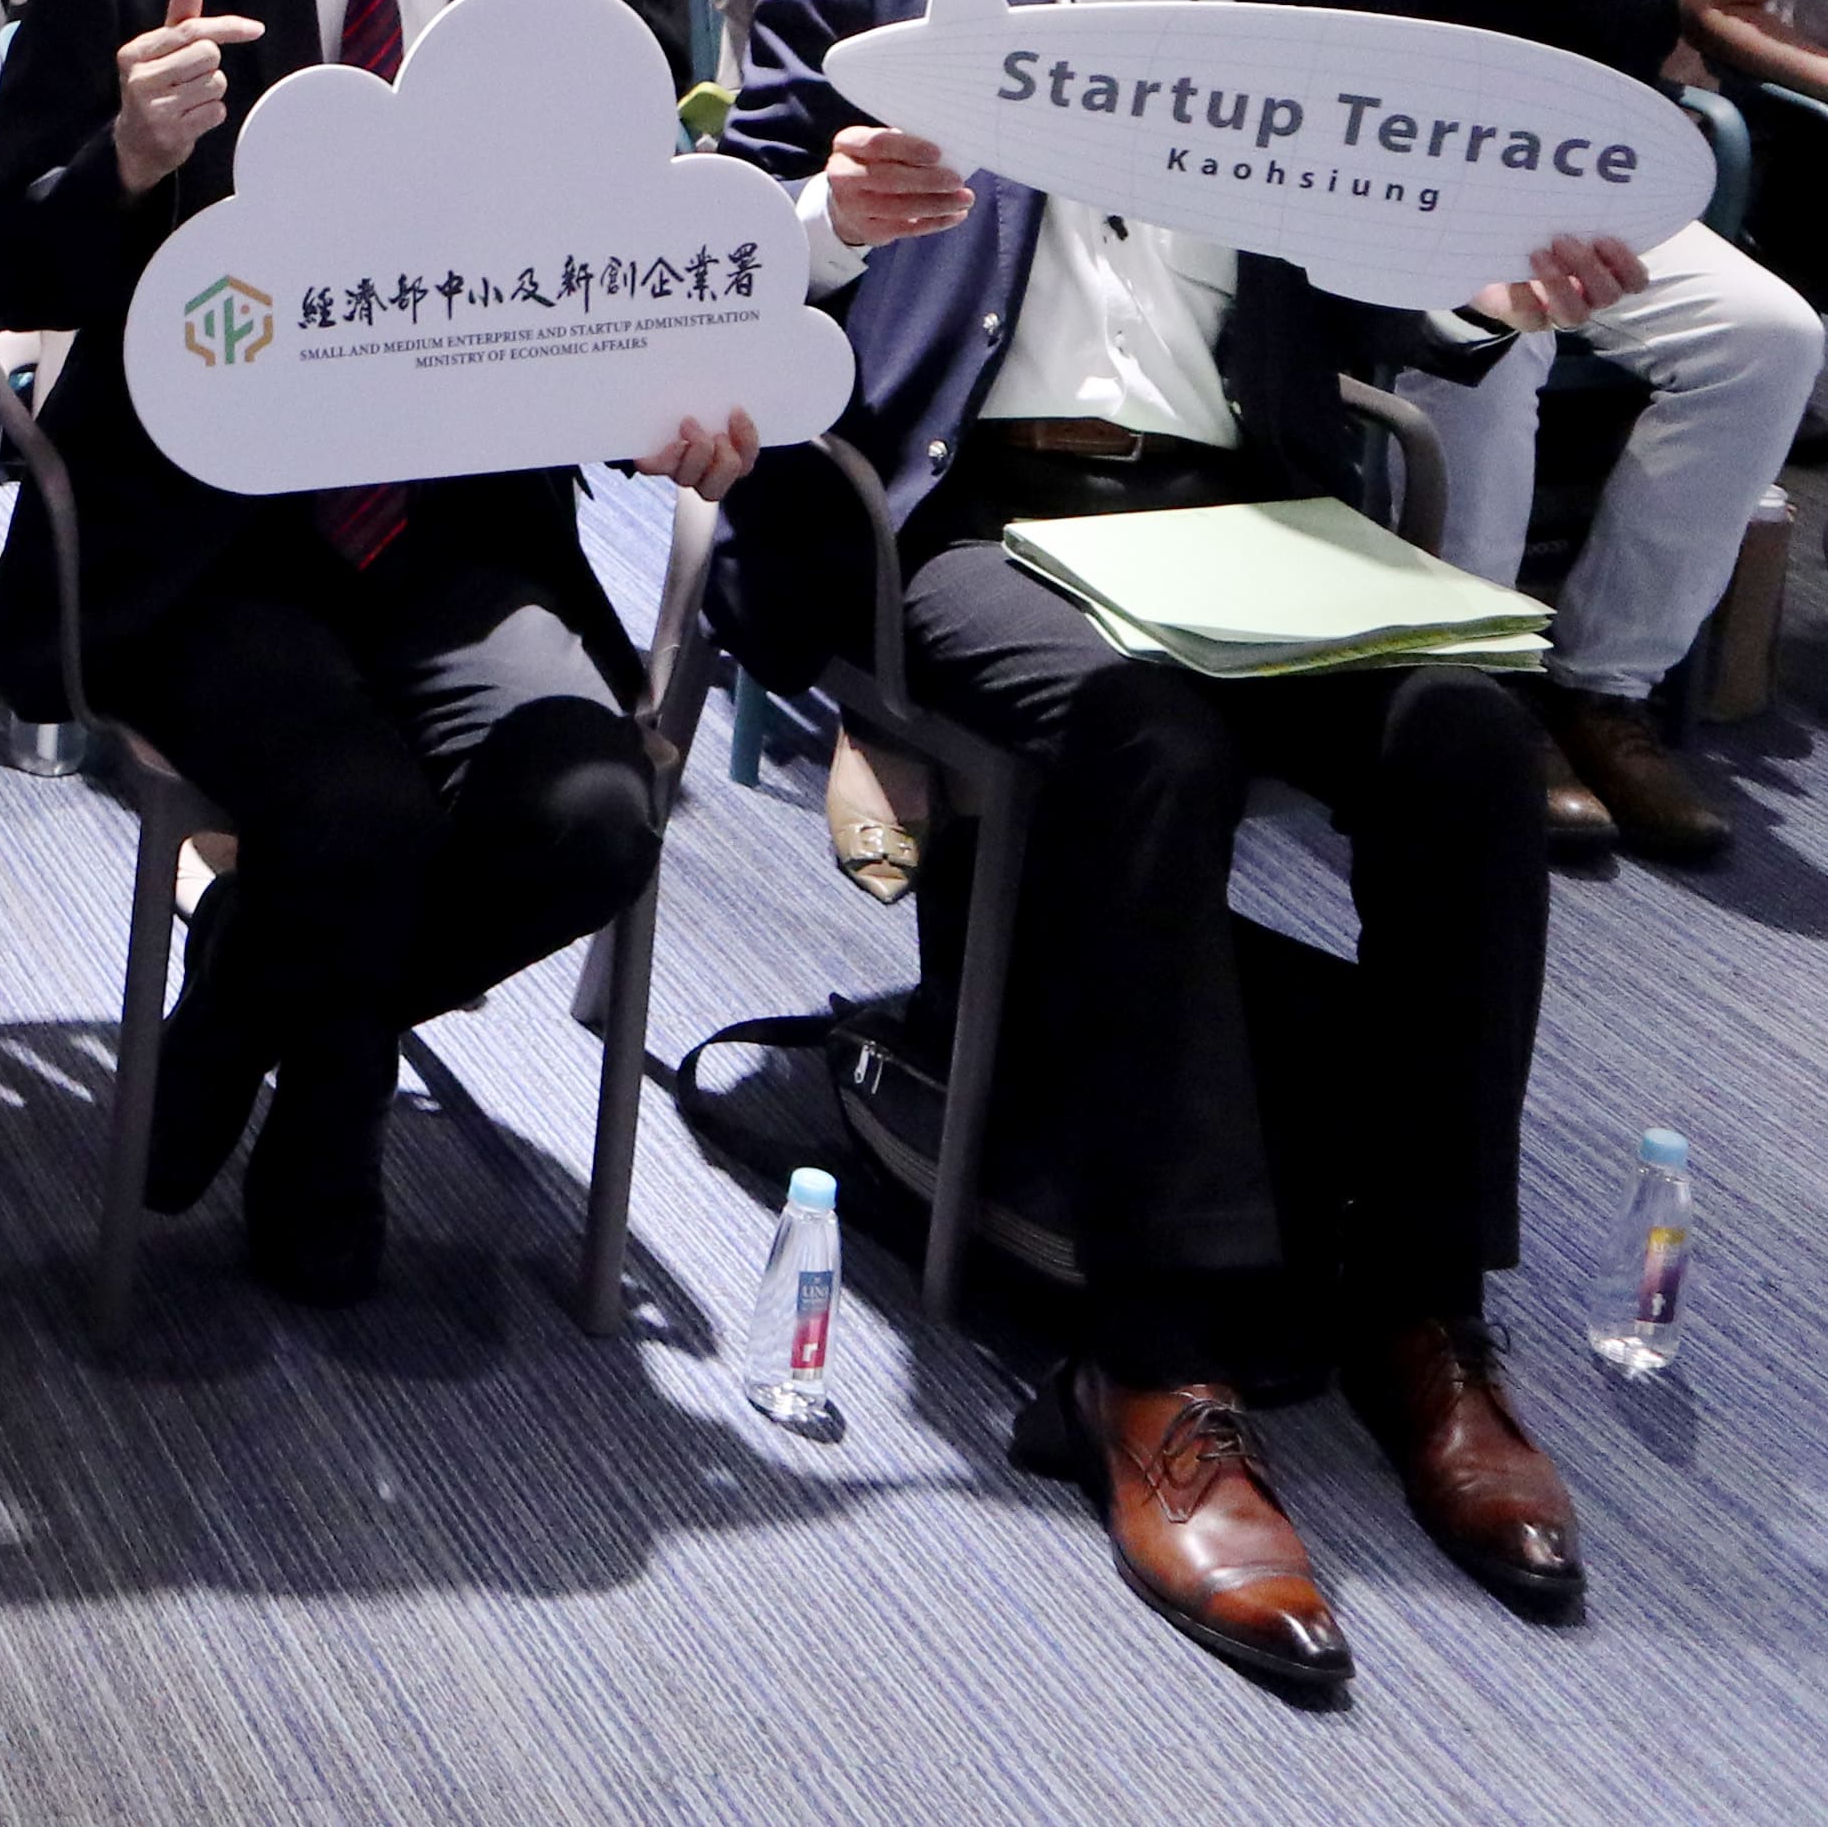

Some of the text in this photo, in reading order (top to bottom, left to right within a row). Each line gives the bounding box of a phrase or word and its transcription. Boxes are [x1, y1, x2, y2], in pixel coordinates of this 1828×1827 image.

[996, 48, 1639, 185] Startup Terrace
[1165, 146, 1442, 212] Kaohsiung
[297, 241, 764, 330] 經濟部中小及新創企業署
[299, 308, 761, 361] SMALL AND MEDIUM ENTERPRISE AND STARTUP ADMINISTRATION
[415, 336, 649, 369] MINISTRY OF ECONOMIC AFFAIRS
